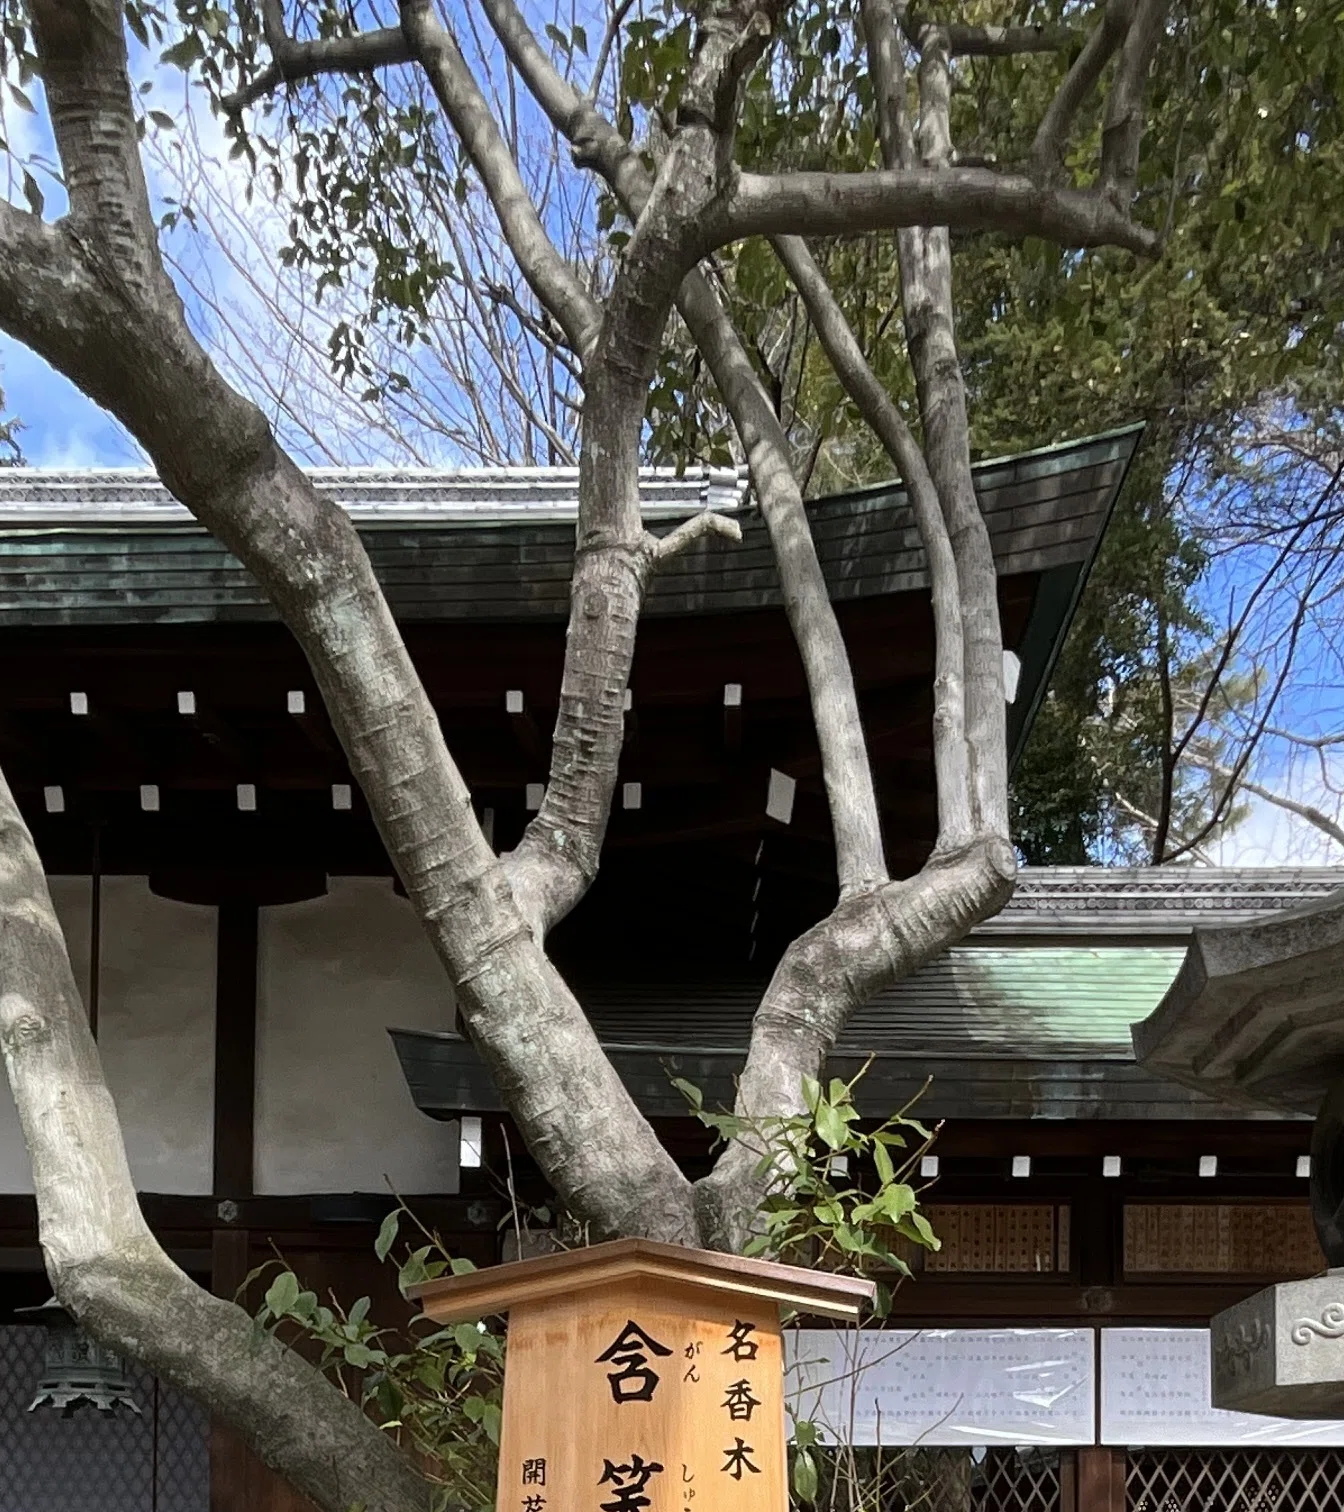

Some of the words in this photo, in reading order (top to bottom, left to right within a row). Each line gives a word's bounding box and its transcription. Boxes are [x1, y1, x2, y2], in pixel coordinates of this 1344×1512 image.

[683, 1340, 703, 1384] がん
[720, 1319, 762, 1481] 名香木
